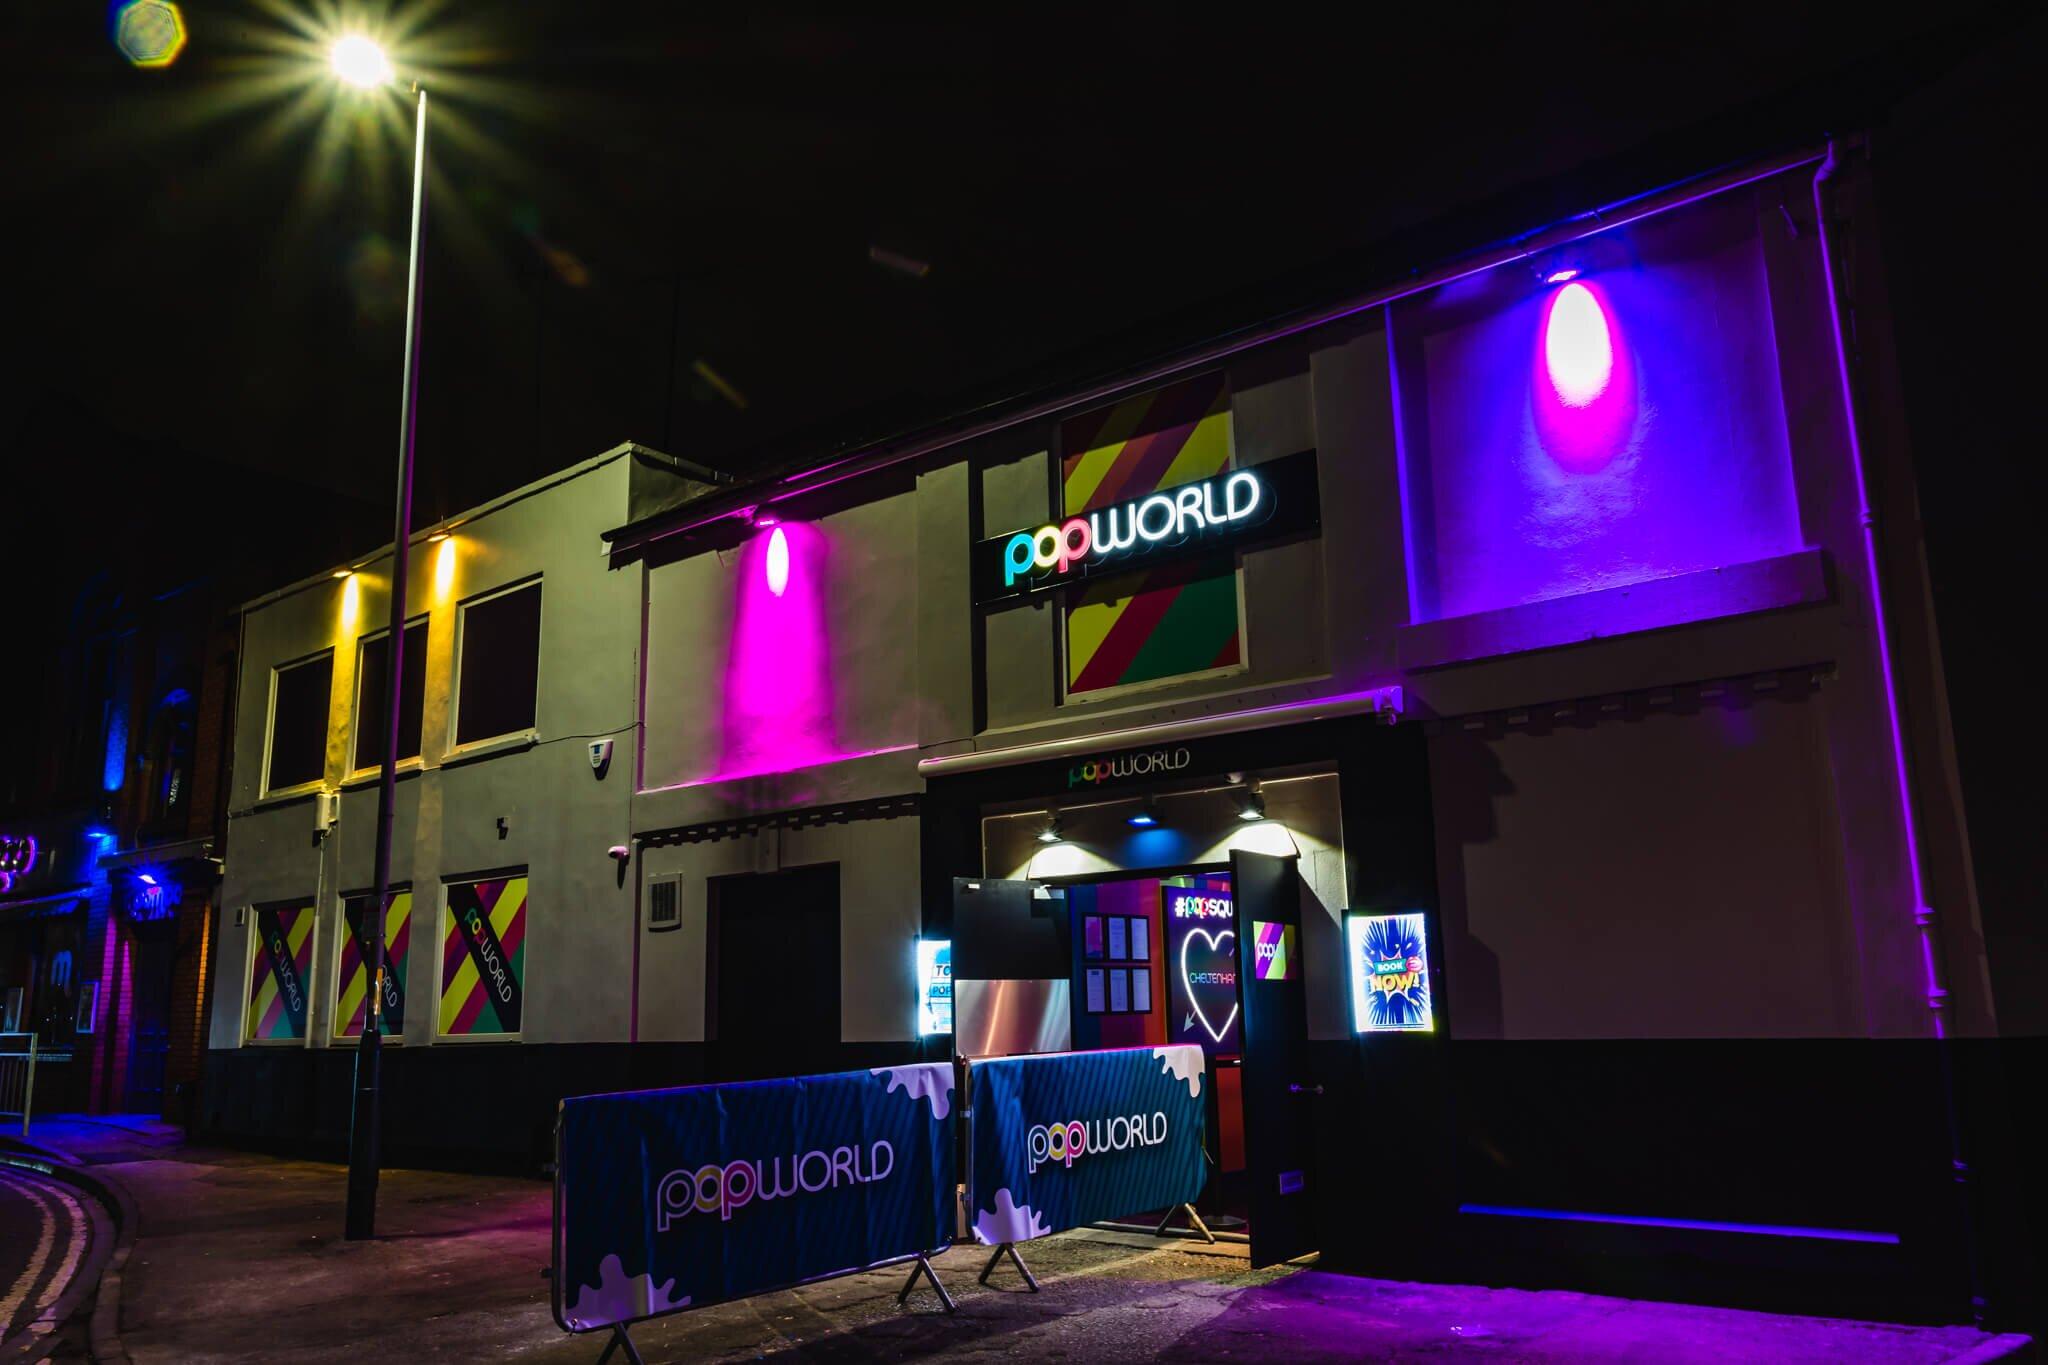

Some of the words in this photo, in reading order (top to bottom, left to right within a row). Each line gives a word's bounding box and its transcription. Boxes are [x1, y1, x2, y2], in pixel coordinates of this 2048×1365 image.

[1005, 472, 1260, 586] popWORLD
[1068, 748, 1190, 788] popWORLD
[465, 907, 512, 1003] popWORLD
[1370, 972, 1420, 992] NOW!
[1377, 962, 1403, 972] BOOK
[1028, 1111, 1167, 1174] popWORLD
[657, 1140, 894, 1232] popWORLD
